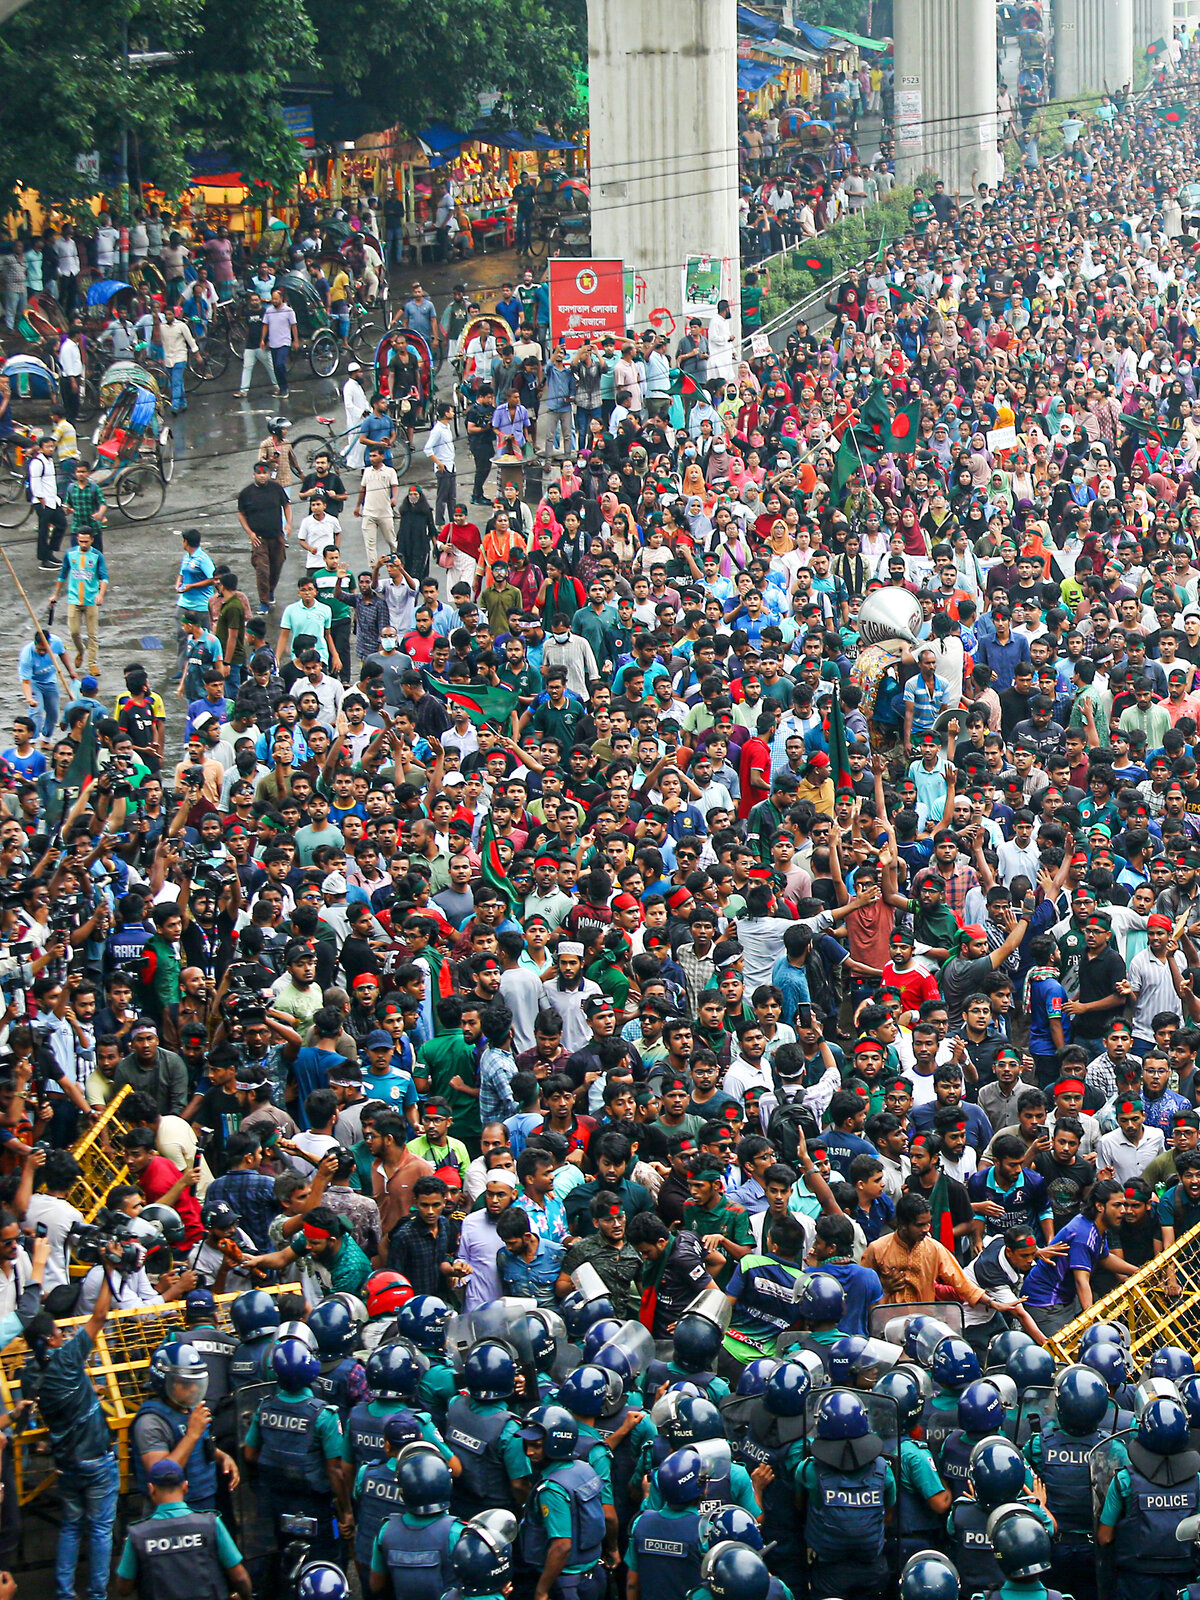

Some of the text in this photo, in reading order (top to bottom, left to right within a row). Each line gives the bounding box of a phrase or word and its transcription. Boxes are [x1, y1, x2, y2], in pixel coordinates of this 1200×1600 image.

[558, 304, 618, 313] হাসপাতাল এলাকায়
[113, 945, 145, 957] RAKI
[343, 1329, 357, 1340] POLICE
[538, 1343, 555, 1357] POLICE
[908, 1405, 922, 1416] POLICE
[987, 1400, 999, 1411] POLICE
[261, 1411, 309, 1431] POLICE
[357, 1434, 384, 1448] POLIC
[552, 1431, 572, 1439] POLICE
[743, 1442, 769, 1464] POLICE
[946, 1464, 973, 1478] POLIC
[678, 1472, 695, 1485] POLICE
[366, 1480, 405, 1503] POLI
[826, 1490, 880, 1504] POLICE
[1147, 1495, 1188, 1507] POLICE
[146, 1534, 202, 1552] POLICE
[966, 1532, 991, 1544] POL
[648, 1541, 679, 1552] POLICE
[491, 1562, 510, 1576] POLICE
